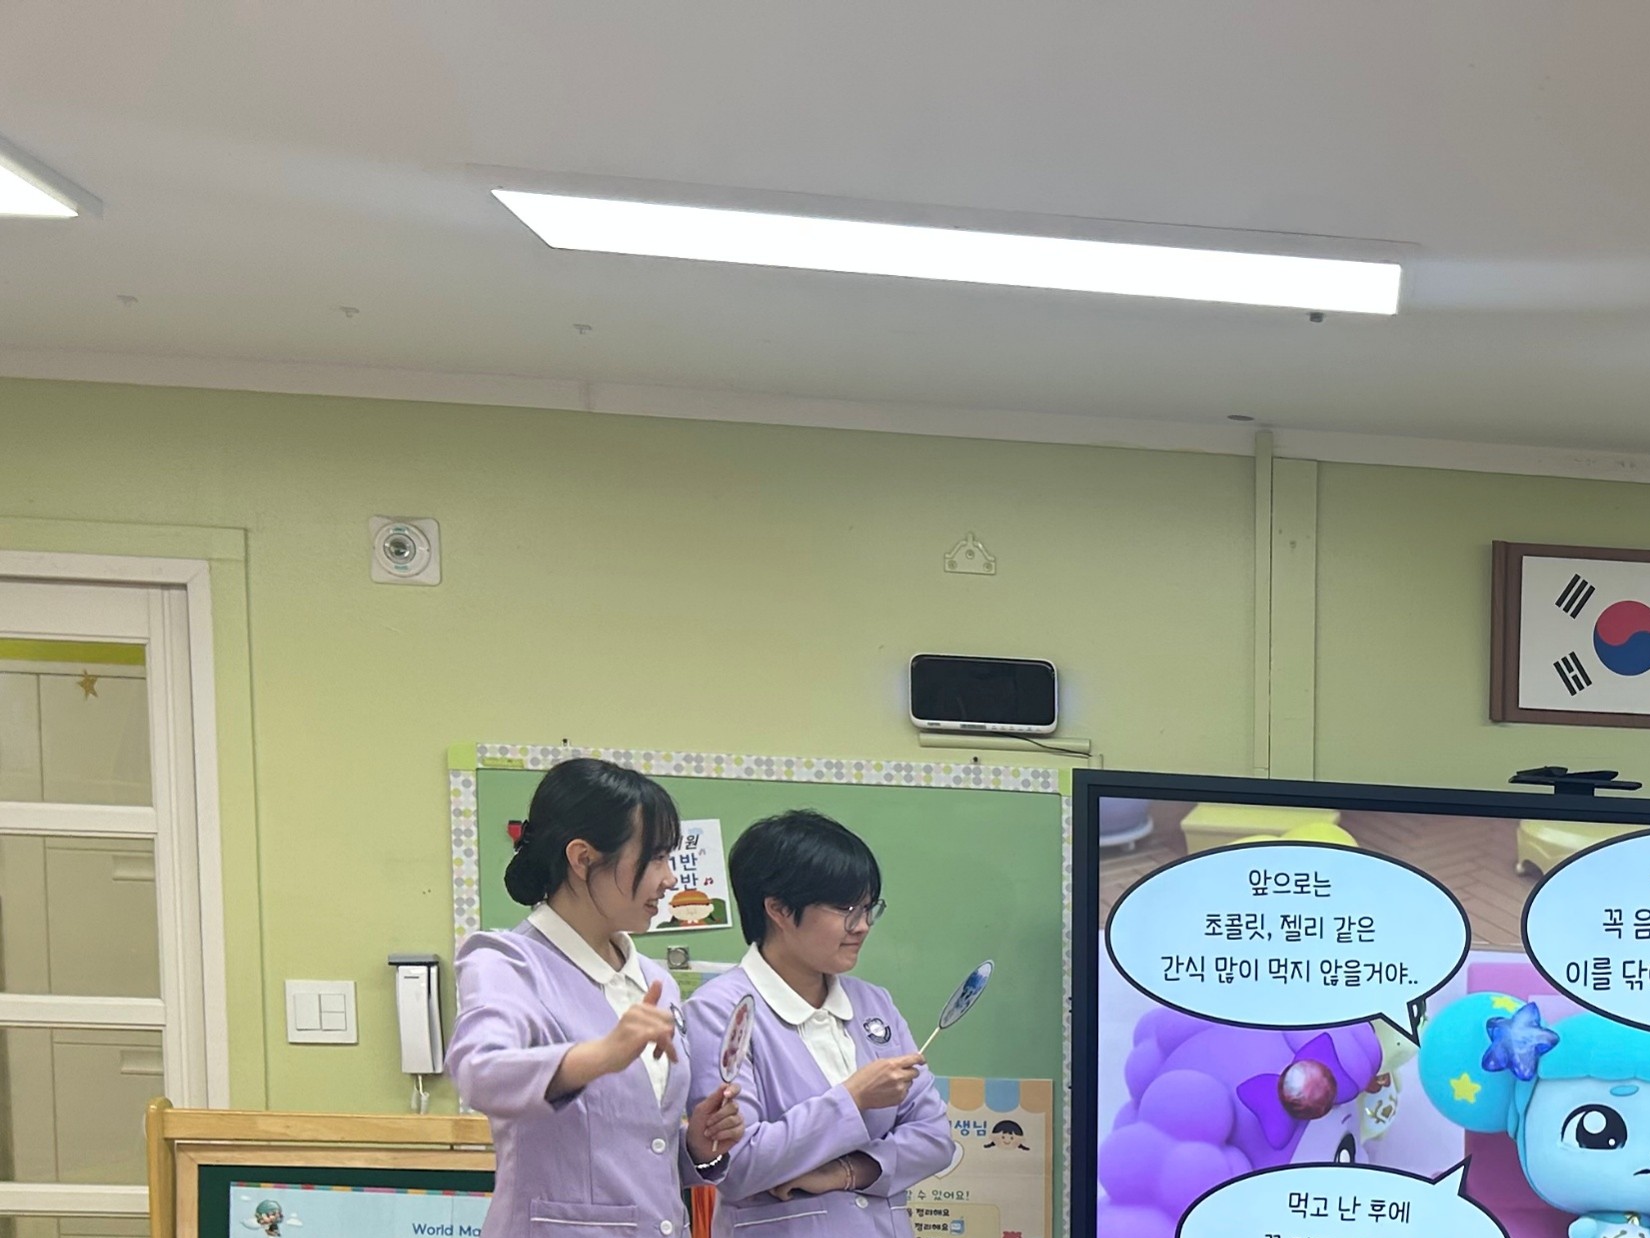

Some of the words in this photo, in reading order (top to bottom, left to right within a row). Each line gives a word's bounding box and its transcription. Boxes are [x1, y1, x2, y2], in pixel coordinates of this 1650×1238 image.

[1248, 869, 1331, 897] 앞으로는
[1204, 913, 1272, 941] 초콜릿,
[1280, 914, 1324, 940] 젤리
[1333, 916, 1376, 943] 같은
[1602, 909, 1624, 940] 꼭
[1161, 956, 1205, 982] 간식
[1215, 957, 1258, 984] 많이
[1269, 959, 1311, 984] 먹지
[1320, 960, 1419, 986] 않을거야..
[1566, 957, 1613, 991] 이를
[948, 1120, 987, 1137] 생님
[917, 1189, 926, 1200] 수
[931, 1189, 970, 1201] 있어요!
[1288, 1192, 1329, 1219] 먹고
[1338, 1196, 1361, 1221] 난
[1367, 1200, 1411, 1223] 후에
[412, 1222, 453, 1237] World
[459, 1224, 482, 1237] Ma
